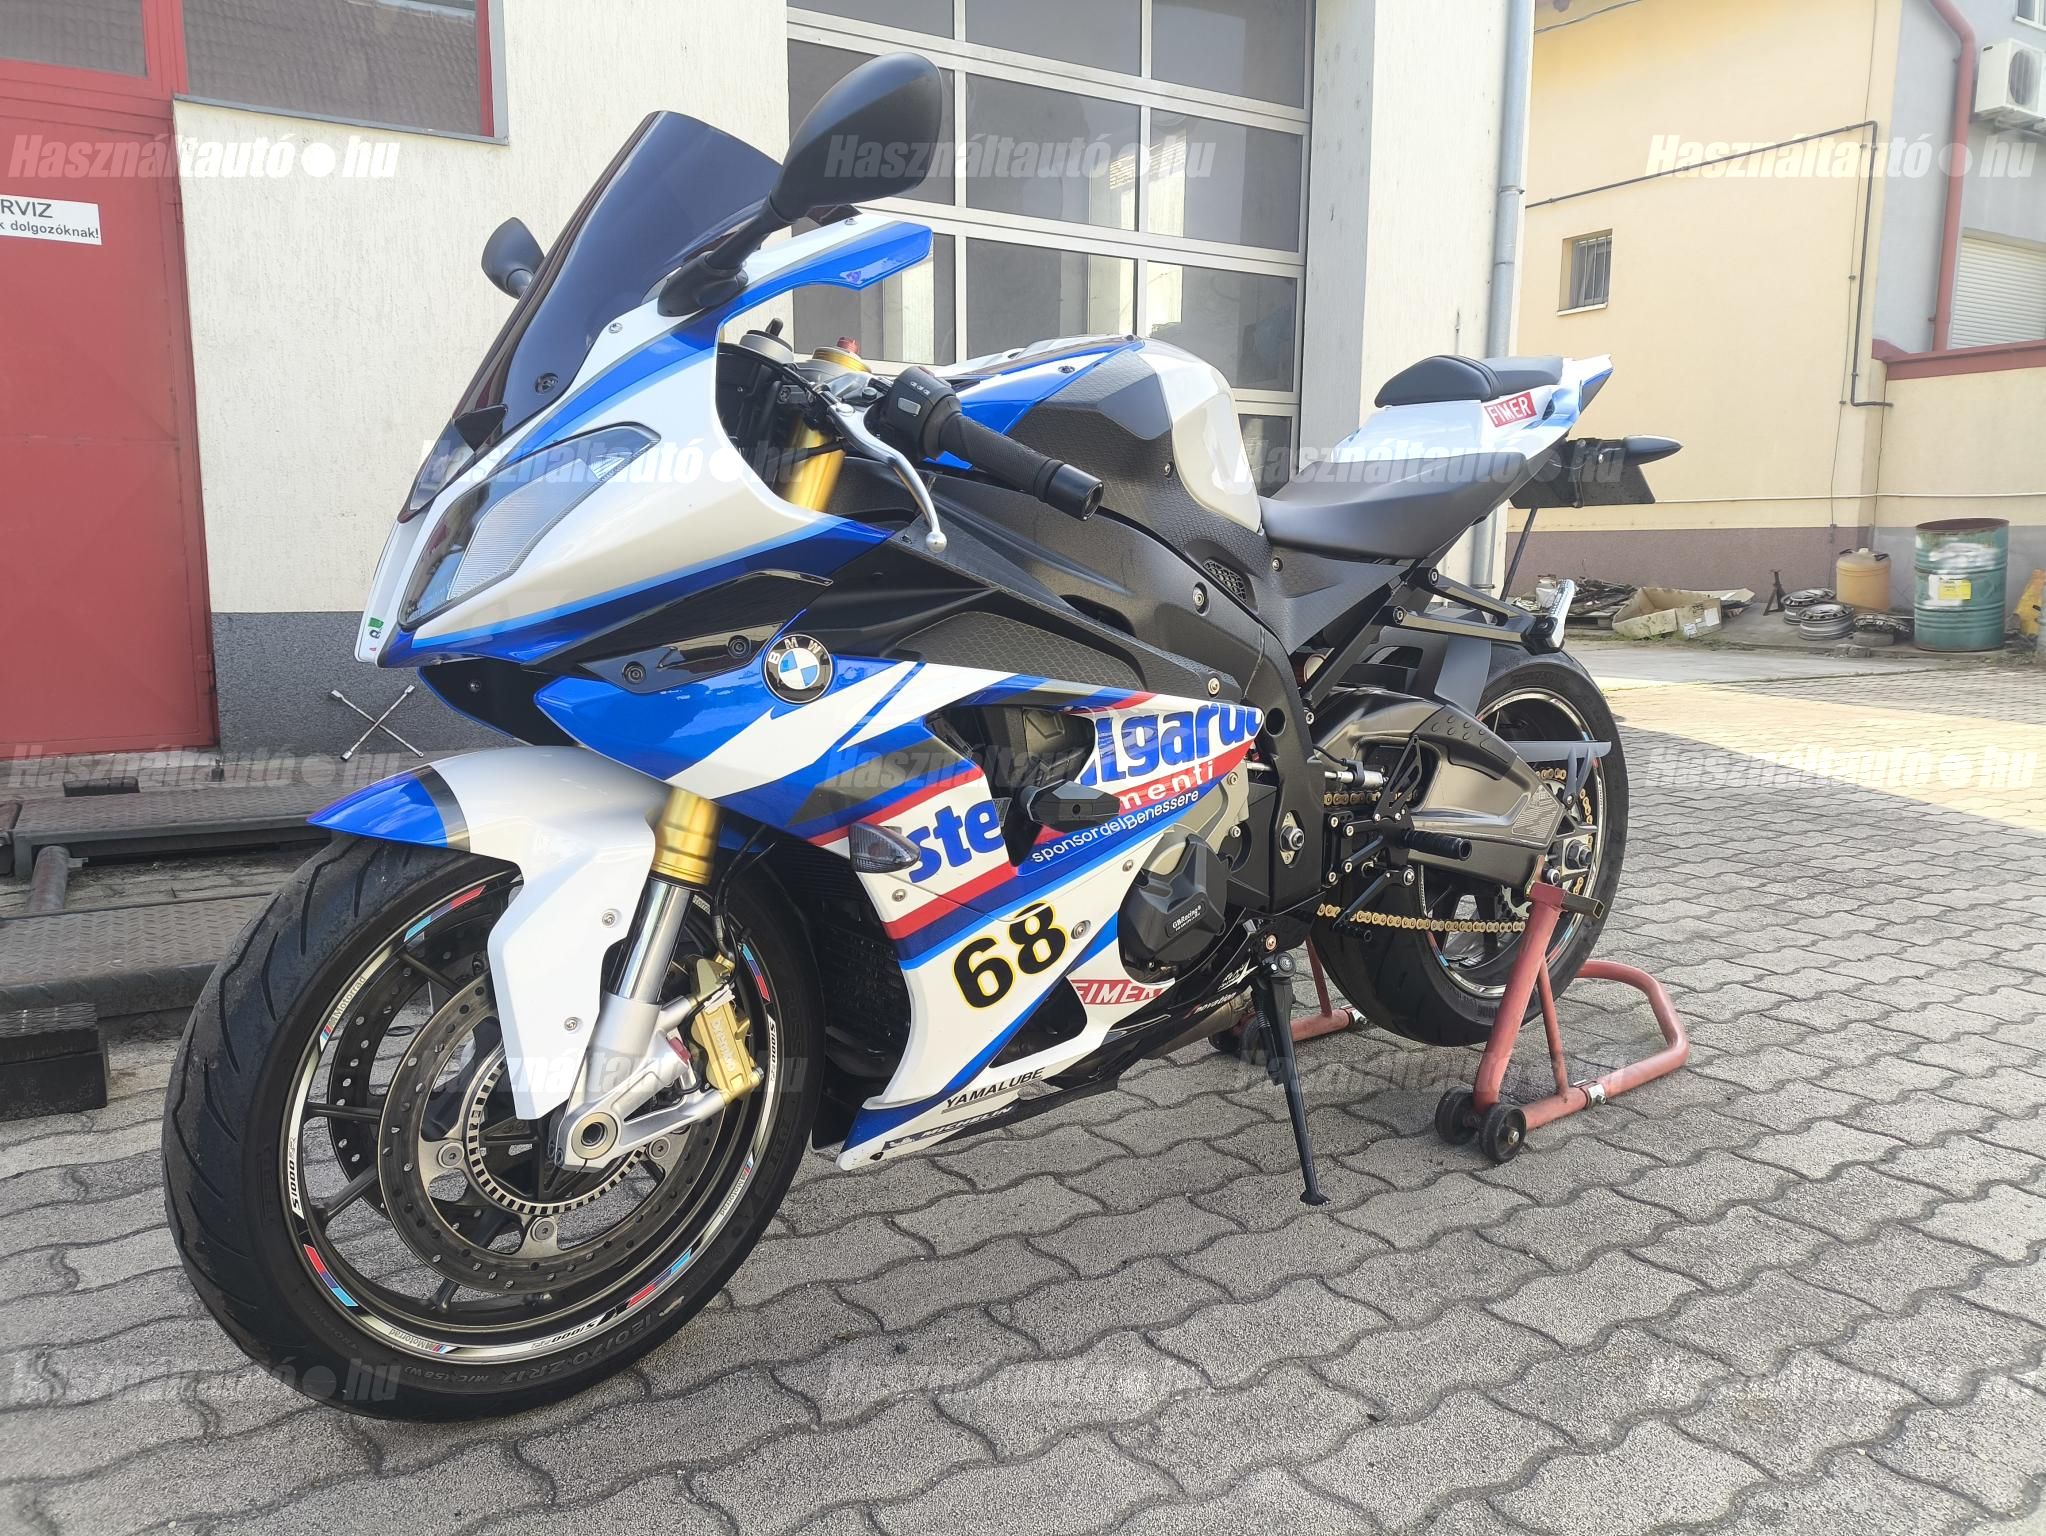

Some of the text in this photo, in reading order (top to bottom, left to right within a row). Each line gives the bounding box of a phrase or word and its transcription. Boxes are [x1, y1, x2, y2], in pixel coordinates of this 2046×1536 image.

[10, 220, 99, 239] dolgozóknak!
[1487, 397, 1532, 425] FIMER
[767, 636, 822, 665] BMW
[953, 901, 1067, 1010] 68
[945, 1066, 1046, 1109] YAMALUBE
